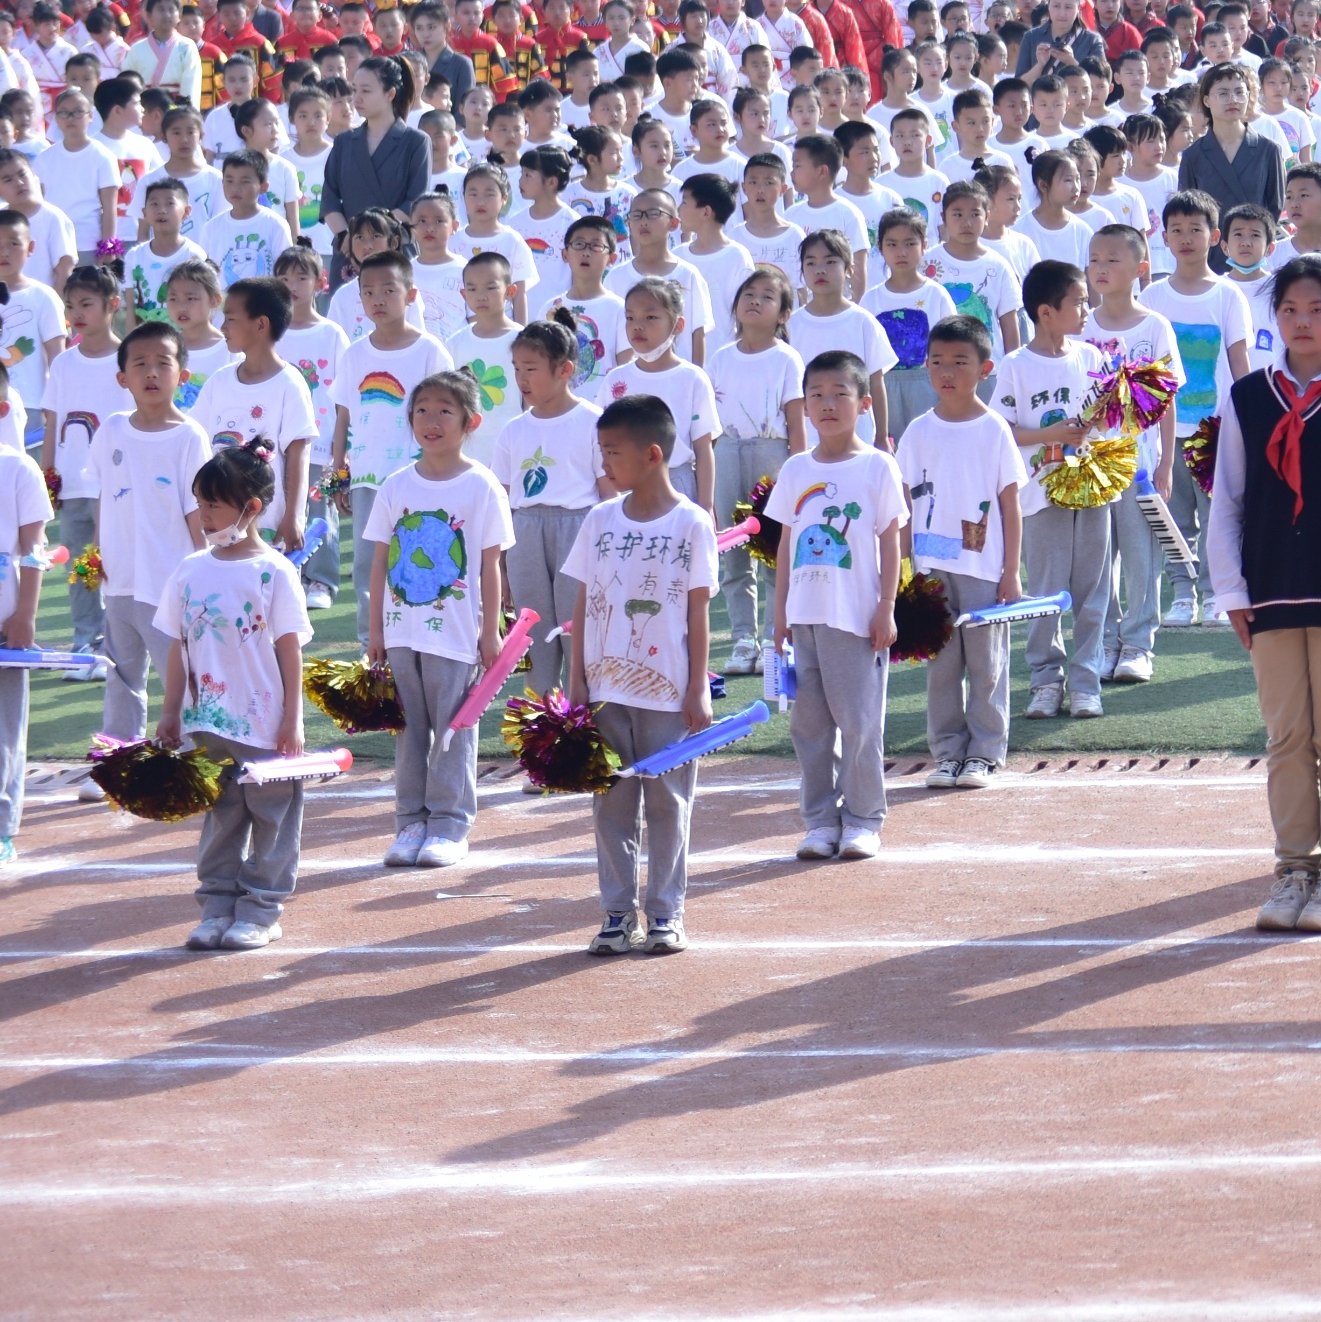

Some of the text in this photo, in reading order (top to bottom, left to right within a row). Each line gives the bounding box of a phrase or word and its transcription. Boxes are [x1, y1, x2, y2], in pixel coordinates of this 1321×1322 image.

[1031, 387, 1070, 410] 环保
[595, 531, 691, 573] 保护环境
[590, 570, 684, 609] 人人有责
[386, 611, 444, 633] 环保
